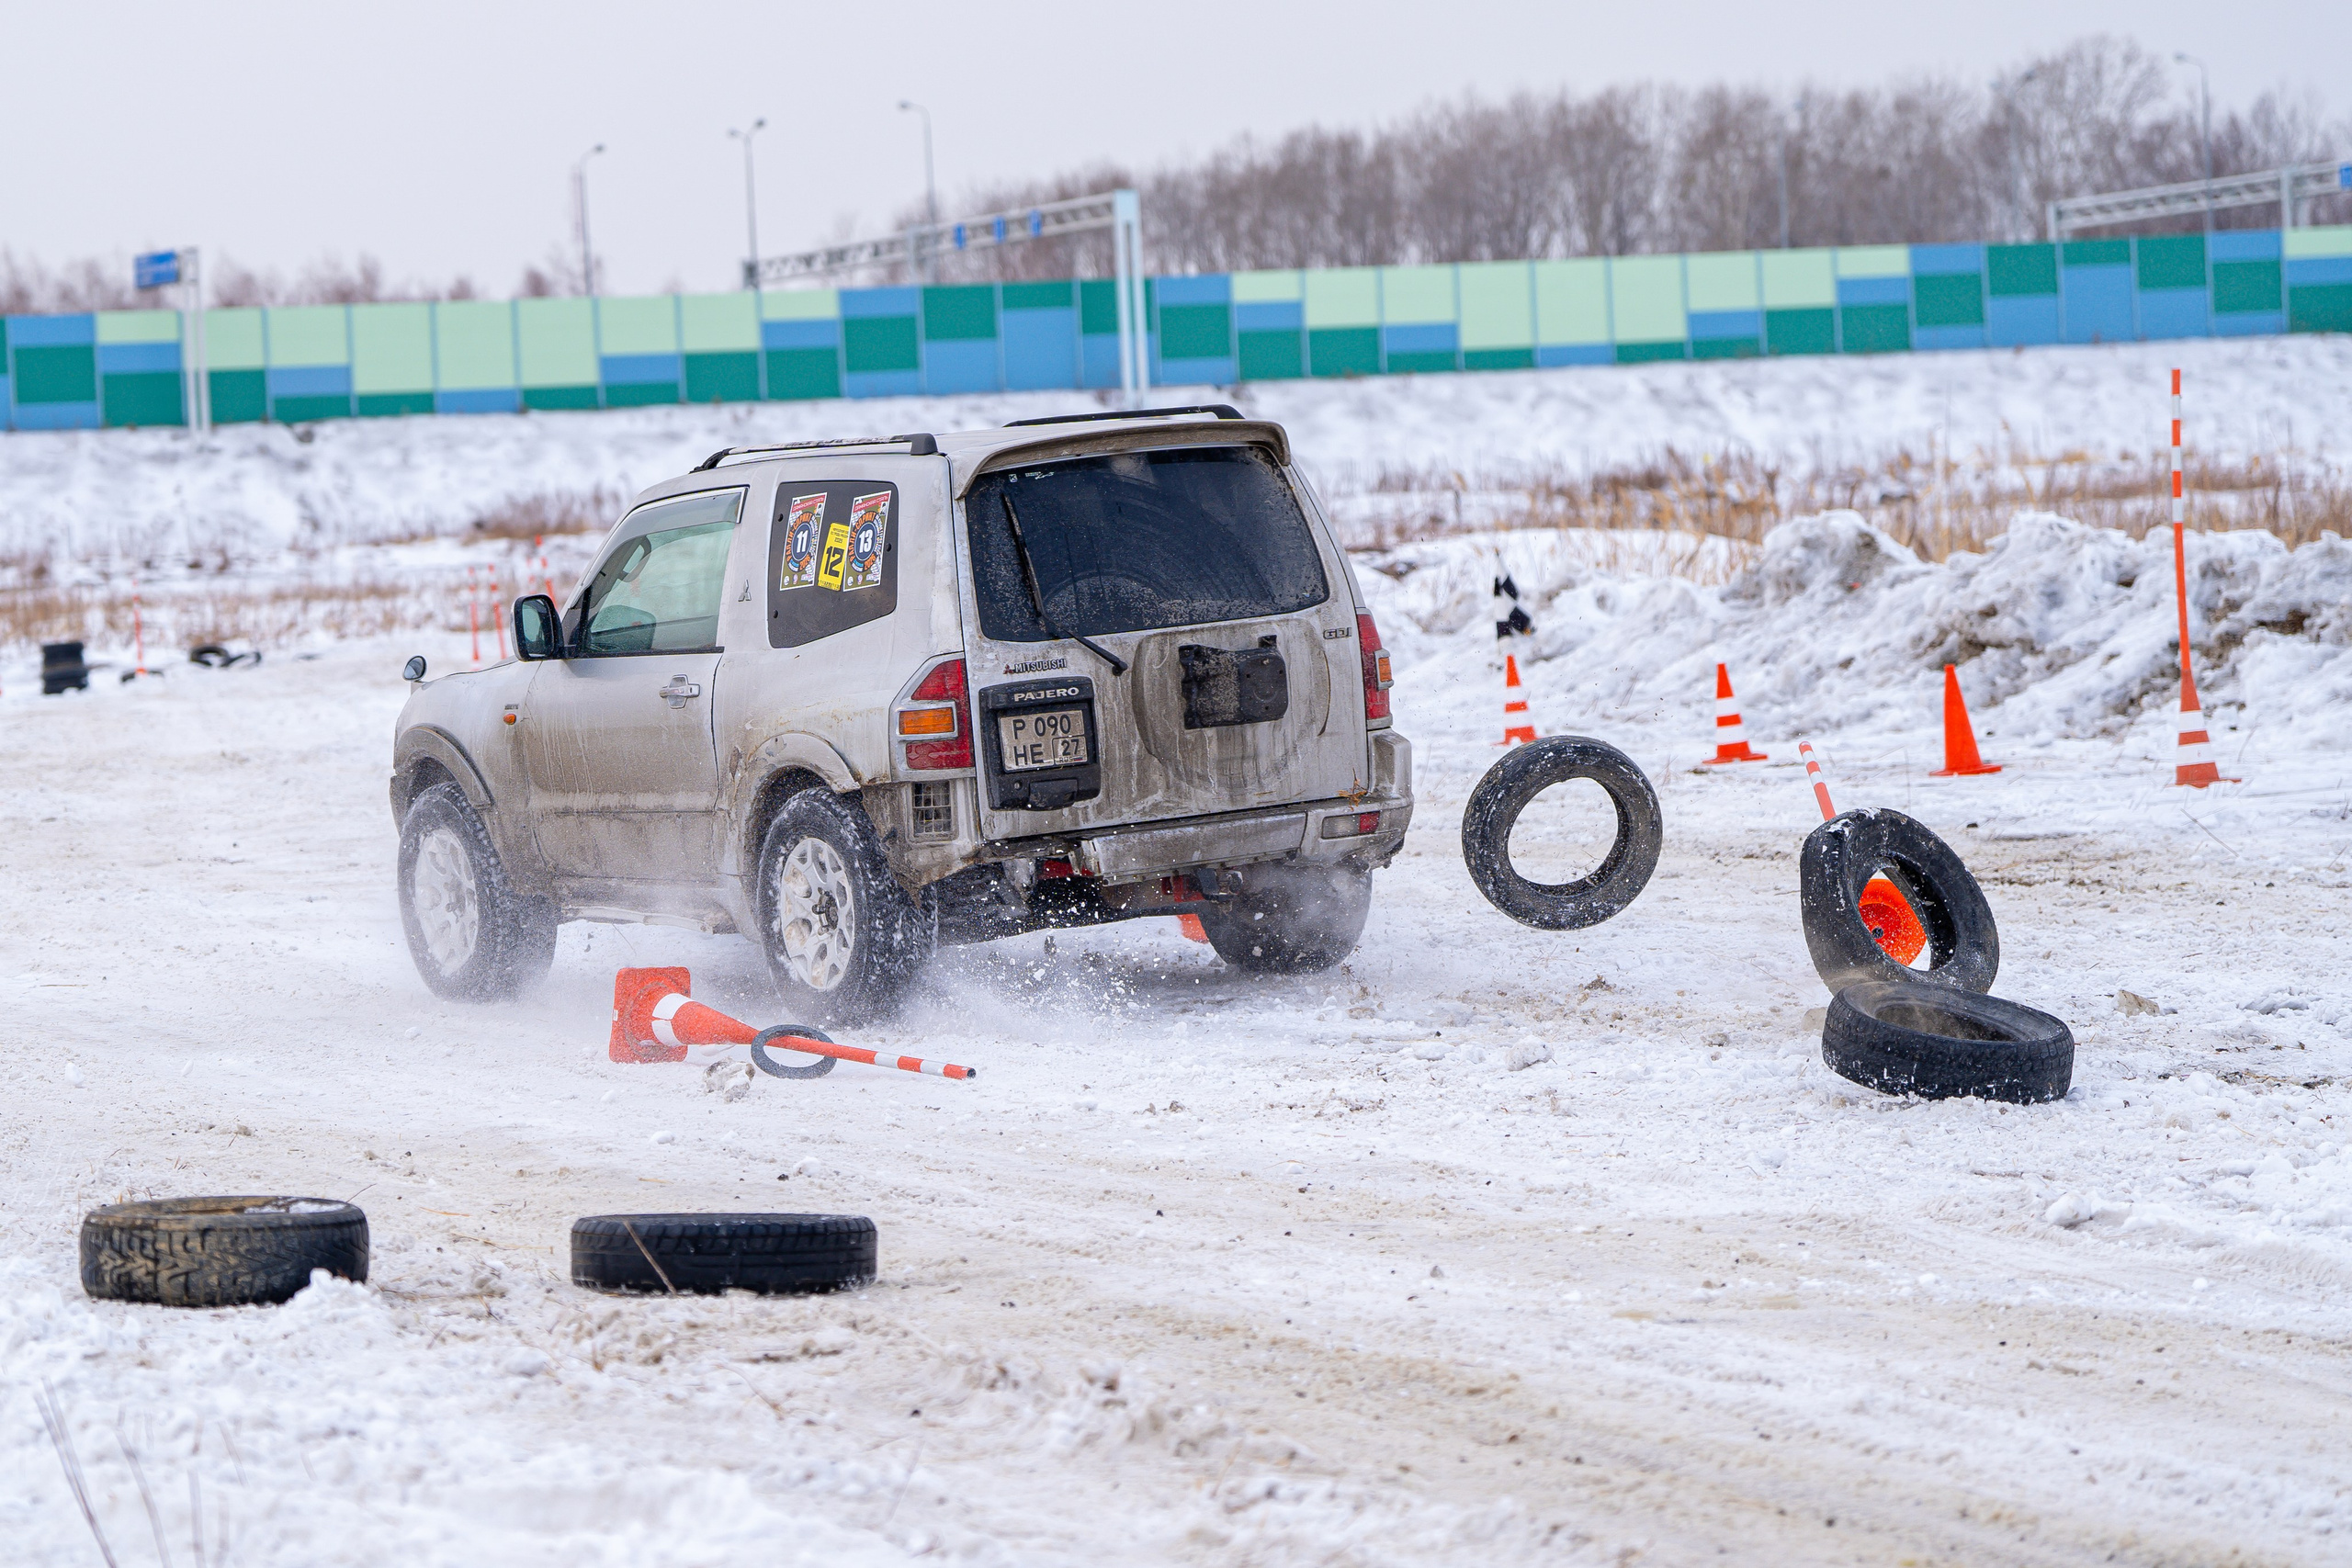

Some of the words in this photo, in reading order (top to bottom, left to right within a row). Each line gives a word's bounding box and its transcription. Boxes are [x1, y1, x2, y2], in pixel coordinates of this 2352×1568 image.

[796, 530, 808, 553] 11
[859, 529, 873, 553] 13
[826, 546, 845, 578] 12
[1323, 627, 1351, 639] GDI
[1014, 659, 1068, 673] MITSUBISHI
[1014, 687, 1080, 702] PAJERO
[1034, 714, 1071, 737] 090
[1060, 739, 1080, 757] 27
